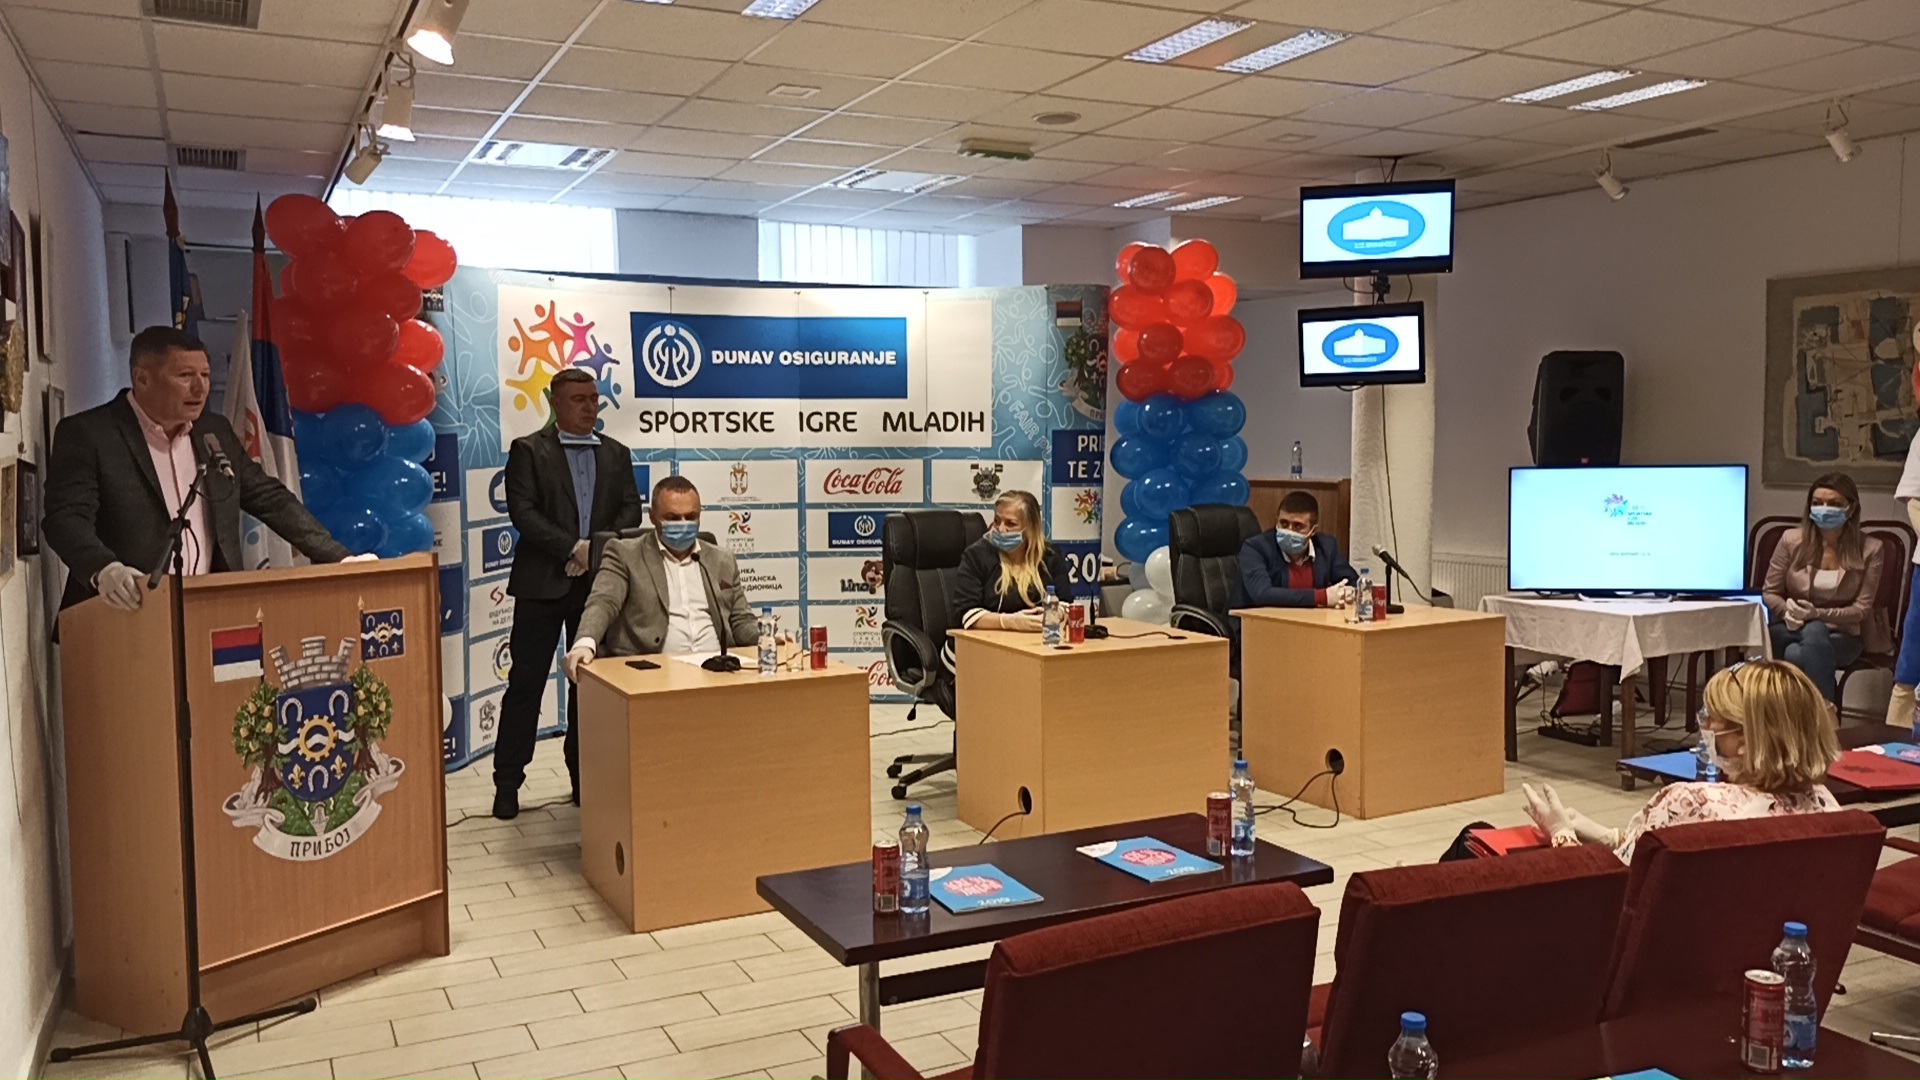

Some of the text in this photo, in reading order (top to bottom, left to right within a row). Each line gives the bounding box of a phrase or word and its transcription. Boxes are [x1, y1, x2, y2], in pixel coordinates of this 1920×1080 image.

[711, 350, 897, 366] DUNAV OSIGURANJE
[639, 410, 985, 433] SPORTSKE IGRE MLADIH
[1067, 461, 1088, 478] TE
[823, 467, 905, 495] Coca-Cola
[840, 578, 870, 593] Lino
[289, 827, 351, 858] ПРИБОЈ
